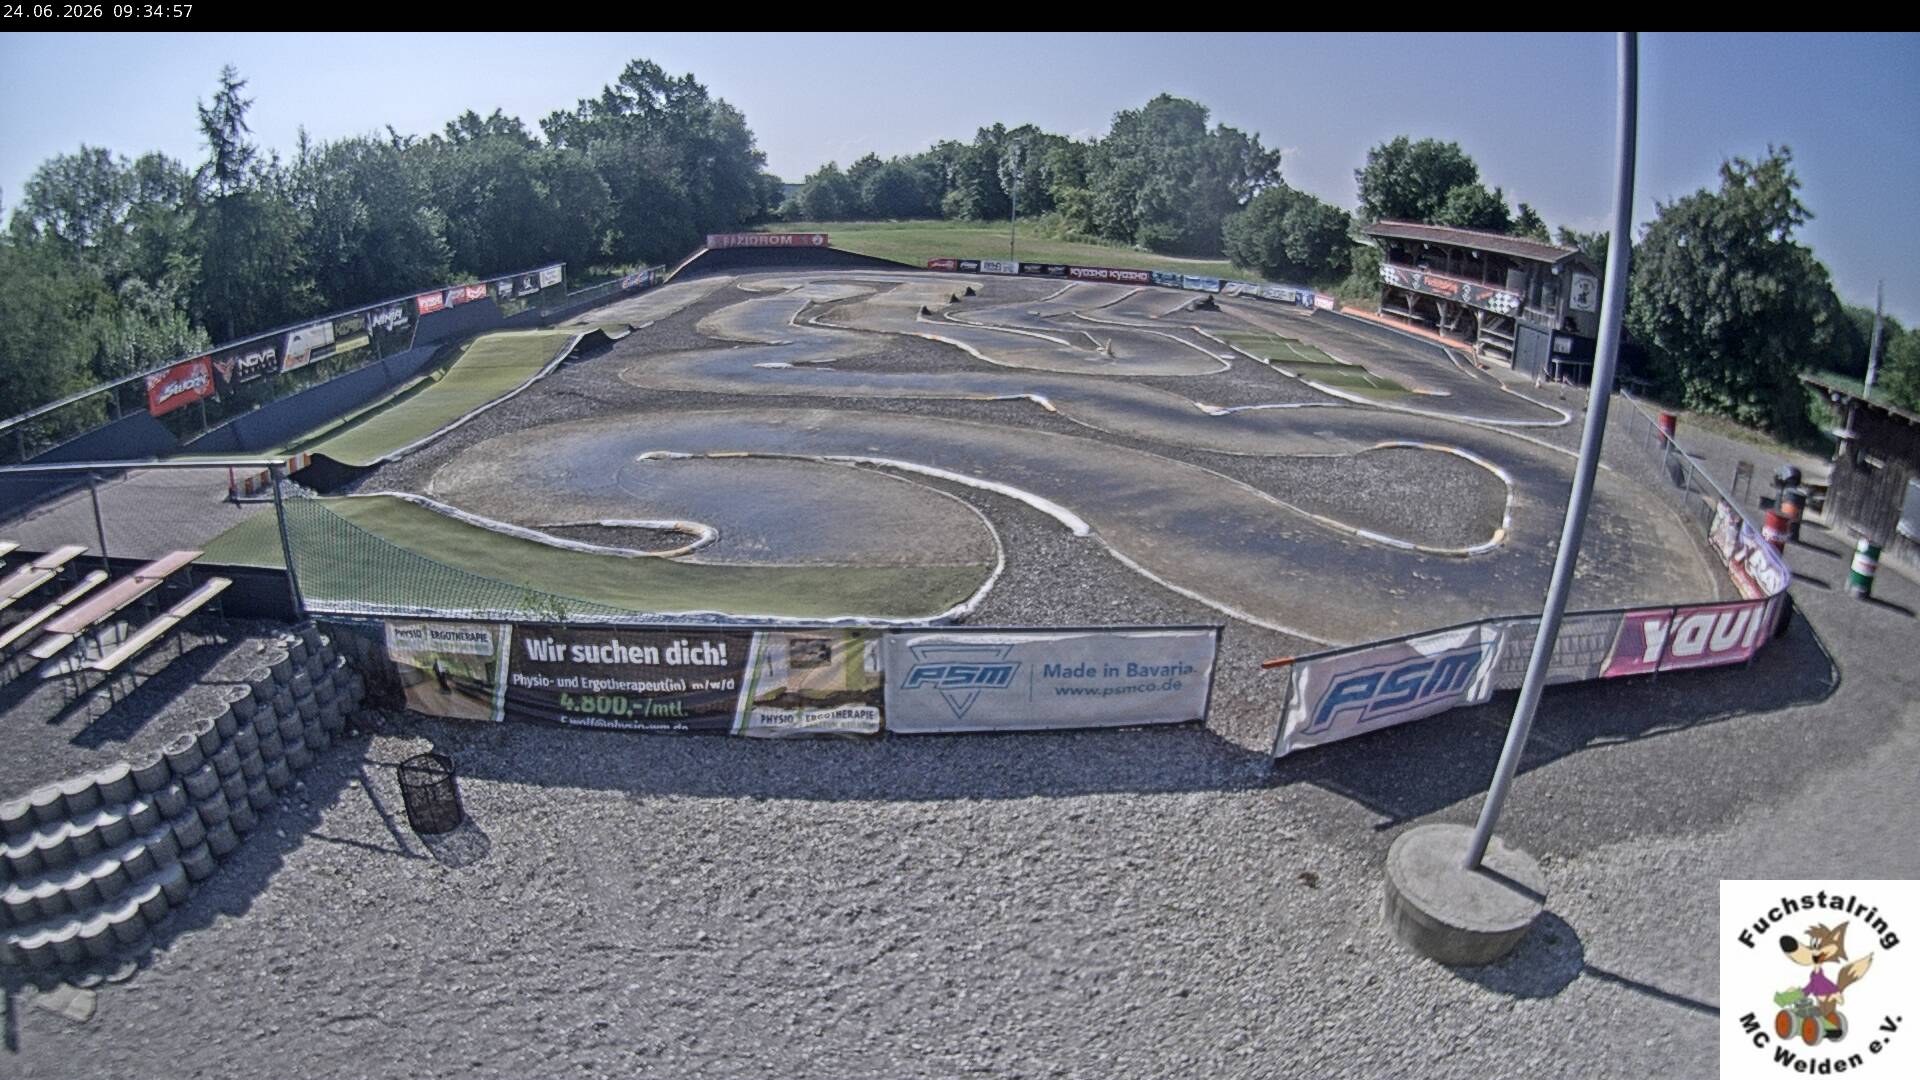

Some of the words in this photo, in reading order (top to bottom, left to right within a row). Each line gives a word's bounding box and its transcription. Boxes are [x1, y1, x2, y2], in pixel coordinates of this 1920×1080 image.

[238, 348, 276, 370] NOVA
[394, 628, 422, 640] PHYSIO
[430, 630, 490, 643] ERGOTHERAPIE
[526, 637, 567, 662] Wir
[572, 639, 660, 665] suchen
[665, 640, 729, 666] dich!
[905, 663, 1014, 688] PSM
[1043, 662, 1097, 679] Made
[1103, 662, 1120, 678] in
[512, 673, 554, 689] Physio-
[557, 676, 579, 689] und
[581, 676, 686, 693] Ergotherapeut(in)
[691, 678, 735, 691] m/w/d
[1055, 678, 1183, 698] www.psmco.de
[1313, 650, 1483, 726] PSM
[761, 713, 795, 725] PHYSIO
